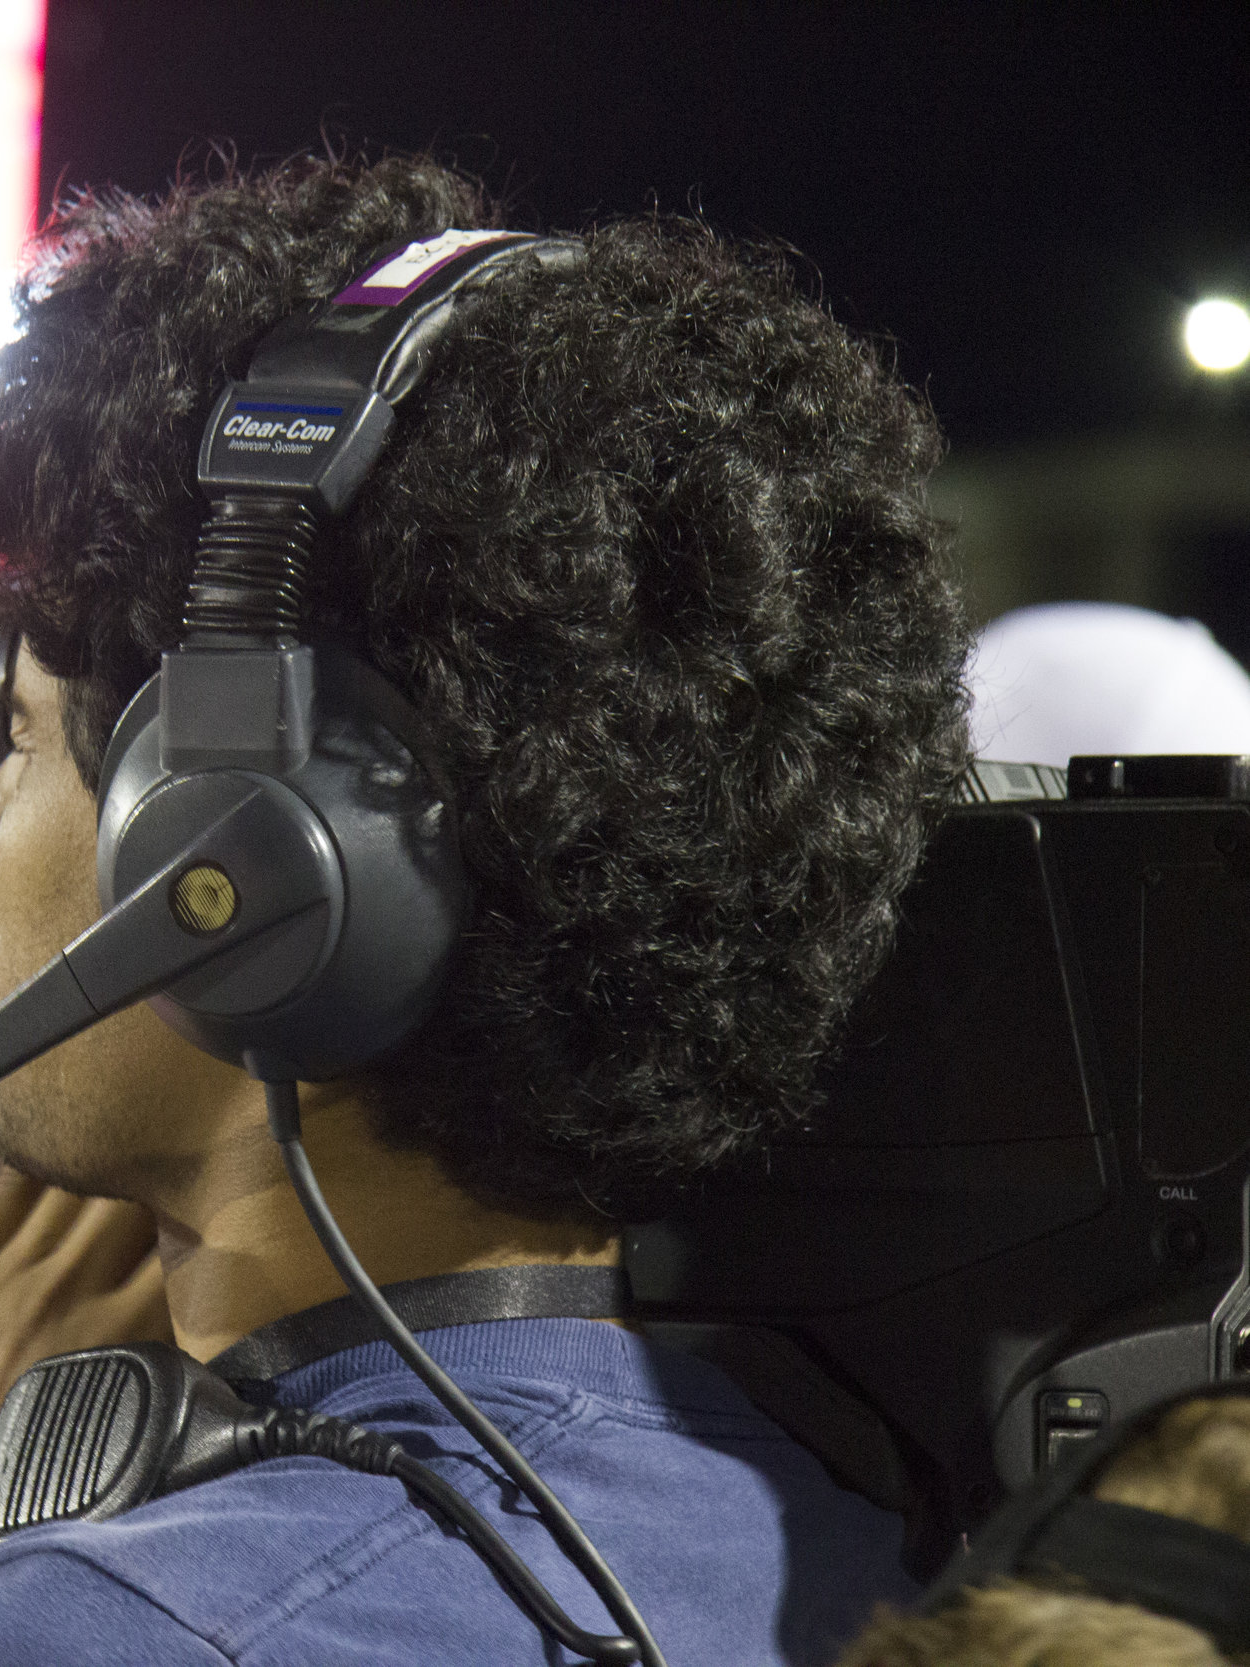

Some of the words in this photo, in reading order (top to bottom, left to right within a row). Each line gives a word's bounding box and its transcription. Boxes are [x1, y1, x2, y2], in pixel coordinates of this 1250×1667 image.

[223, 414, 336, 442] Clear-Com
[229, 438, 271, 452] Intercom
[271, 440, 314, 455] Systems
[1159, 1186, 1199, 1201] CALL
